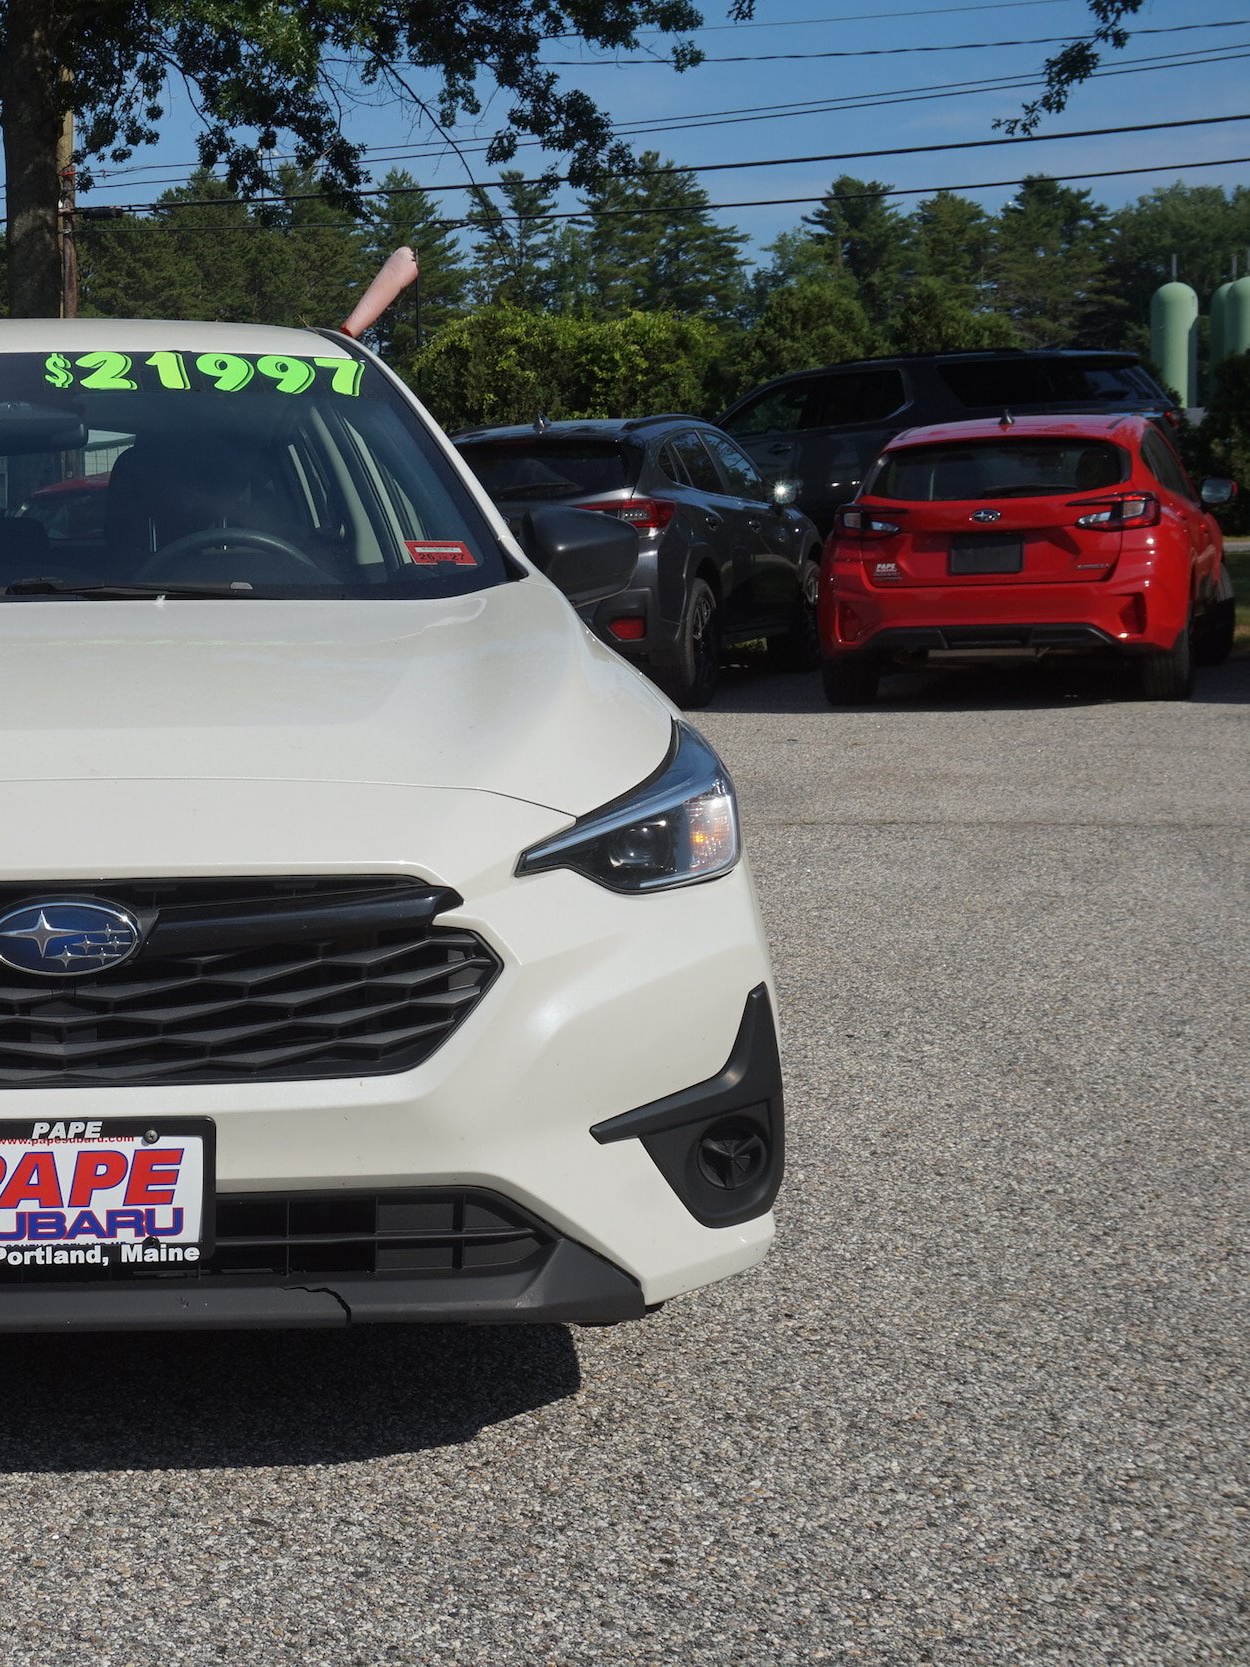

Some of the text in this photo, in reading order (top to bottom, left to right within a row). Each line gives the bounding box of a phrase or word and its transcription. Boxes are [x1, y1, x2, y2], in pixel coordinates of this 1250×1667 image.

[44, 350, 366, 397] $21997
[31, 1120, 103, 1140] PAPE
[121, 1243, 200, 1263] Maine
